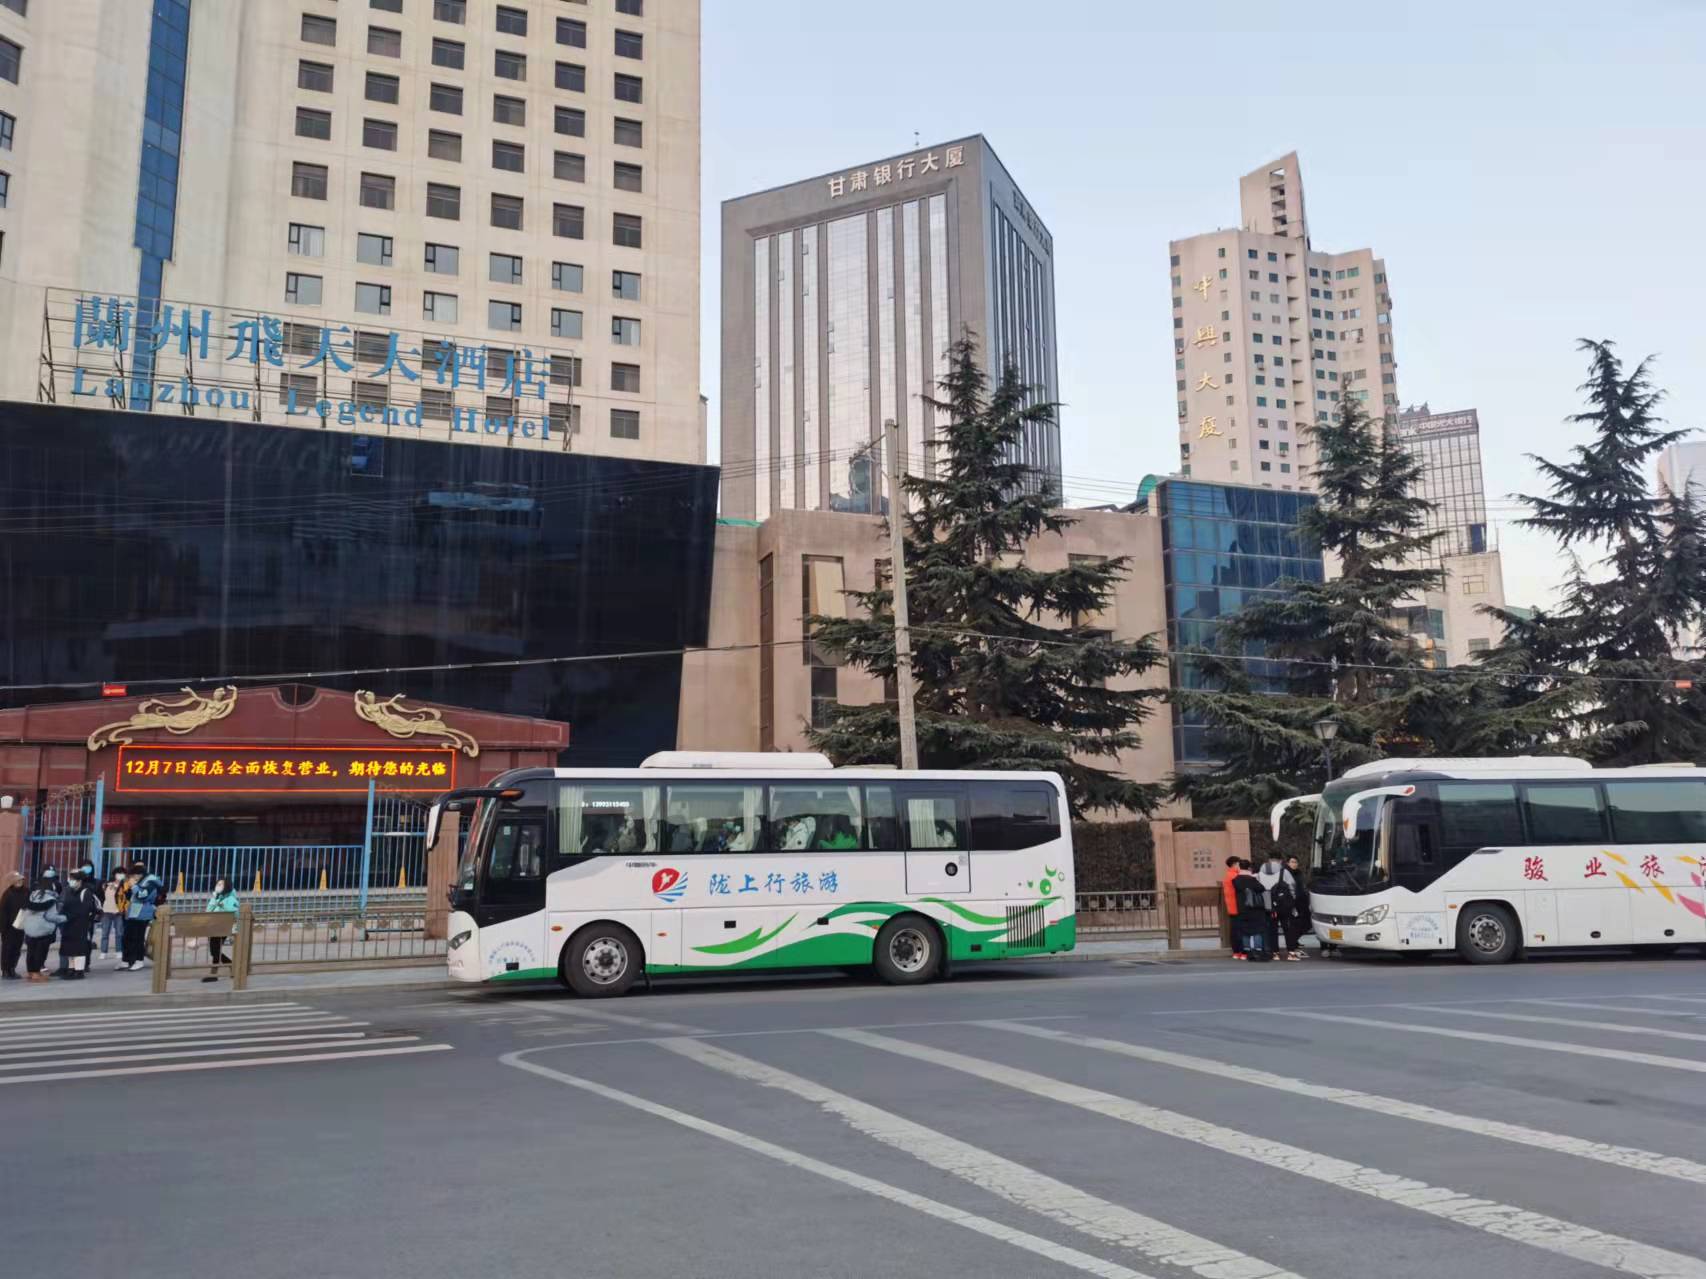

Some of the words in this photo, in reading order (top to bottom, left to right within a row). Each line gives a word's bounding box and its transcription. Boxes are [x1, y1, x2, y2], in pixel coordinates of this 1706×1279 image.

[828, 146, 965, 198] 甘肃银行大厦
[71, 367, 250, 410] Lanzhou
[286, 386, 424, 428] Legend
[453, 406, 549, 440] Hotel
[709, 870, 839, 895] 陇上行旅游
